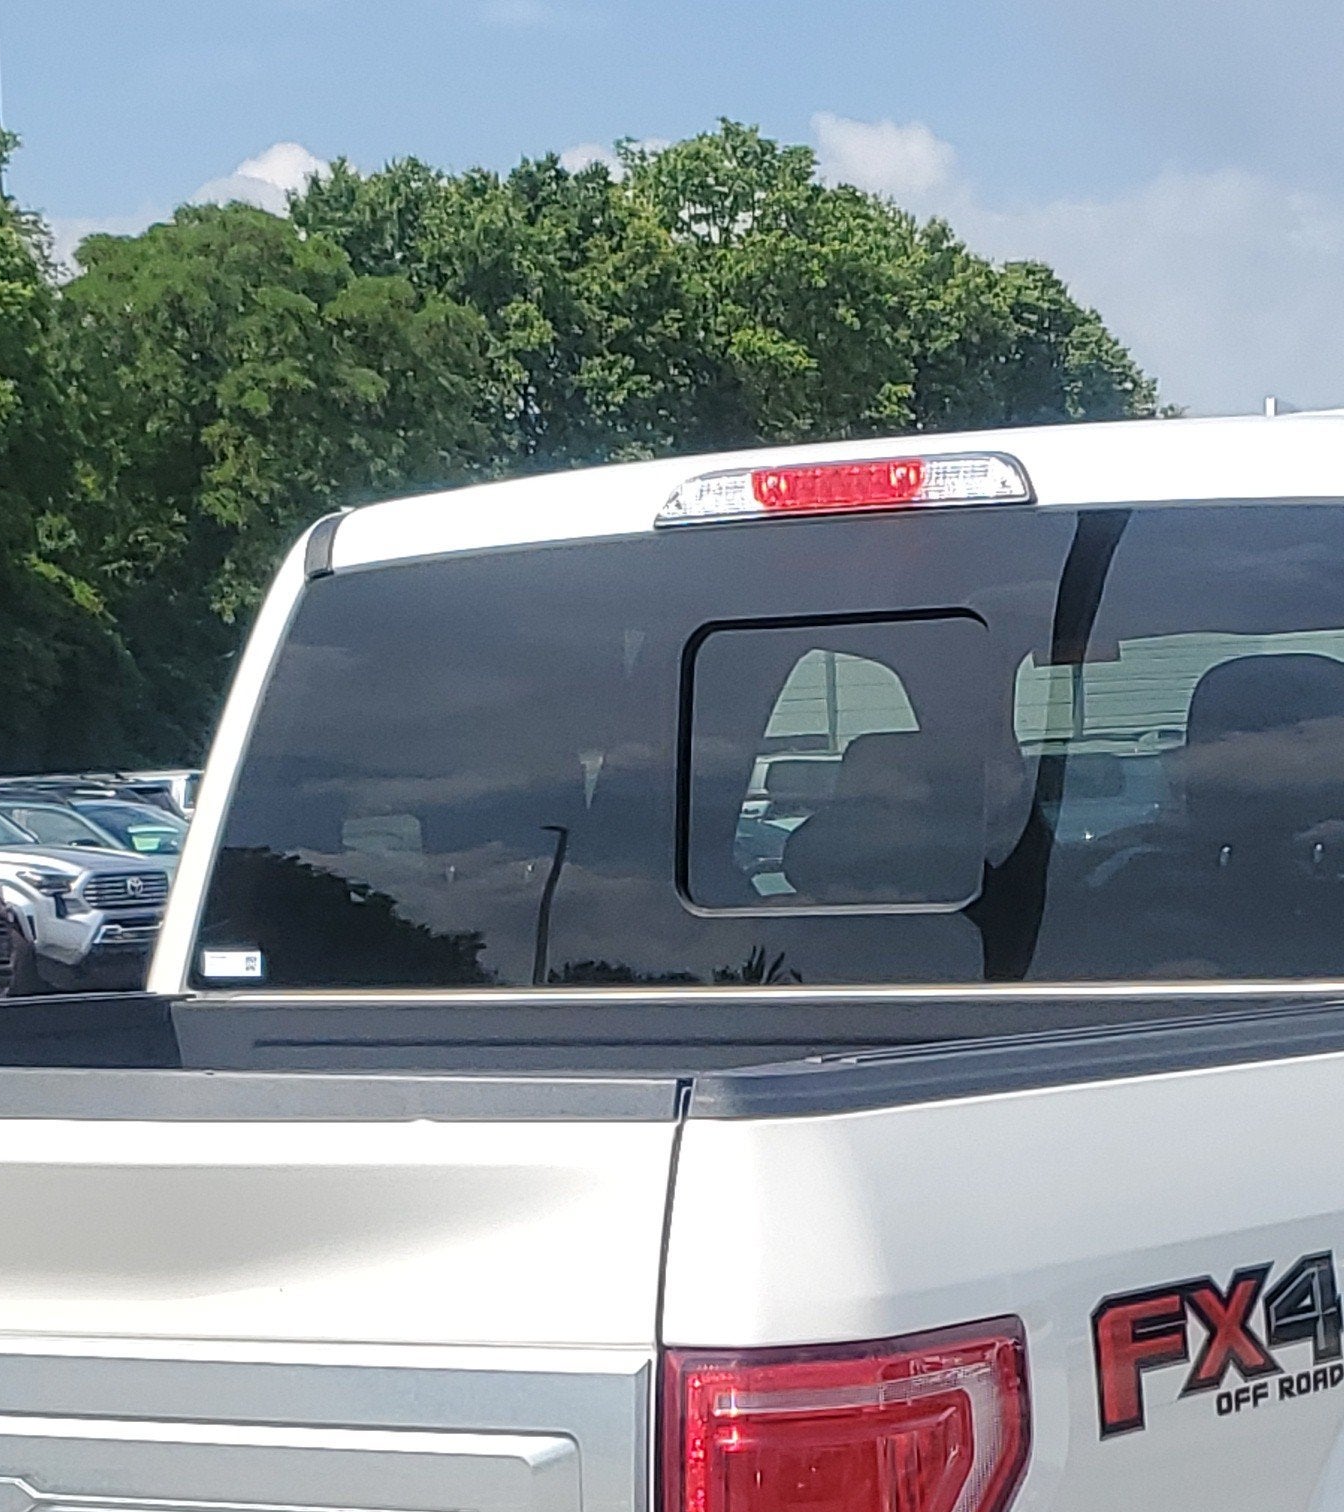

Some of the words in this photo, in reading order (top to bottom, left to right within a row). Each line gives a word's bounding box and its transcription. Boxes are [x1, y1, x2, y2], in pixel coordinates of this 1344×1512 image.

[1090, 1249, 1343, 1441] FX4
[1215, 1382, 1269, 1416] OFF
[1277, 1363, 1344, 1401] ROAD
